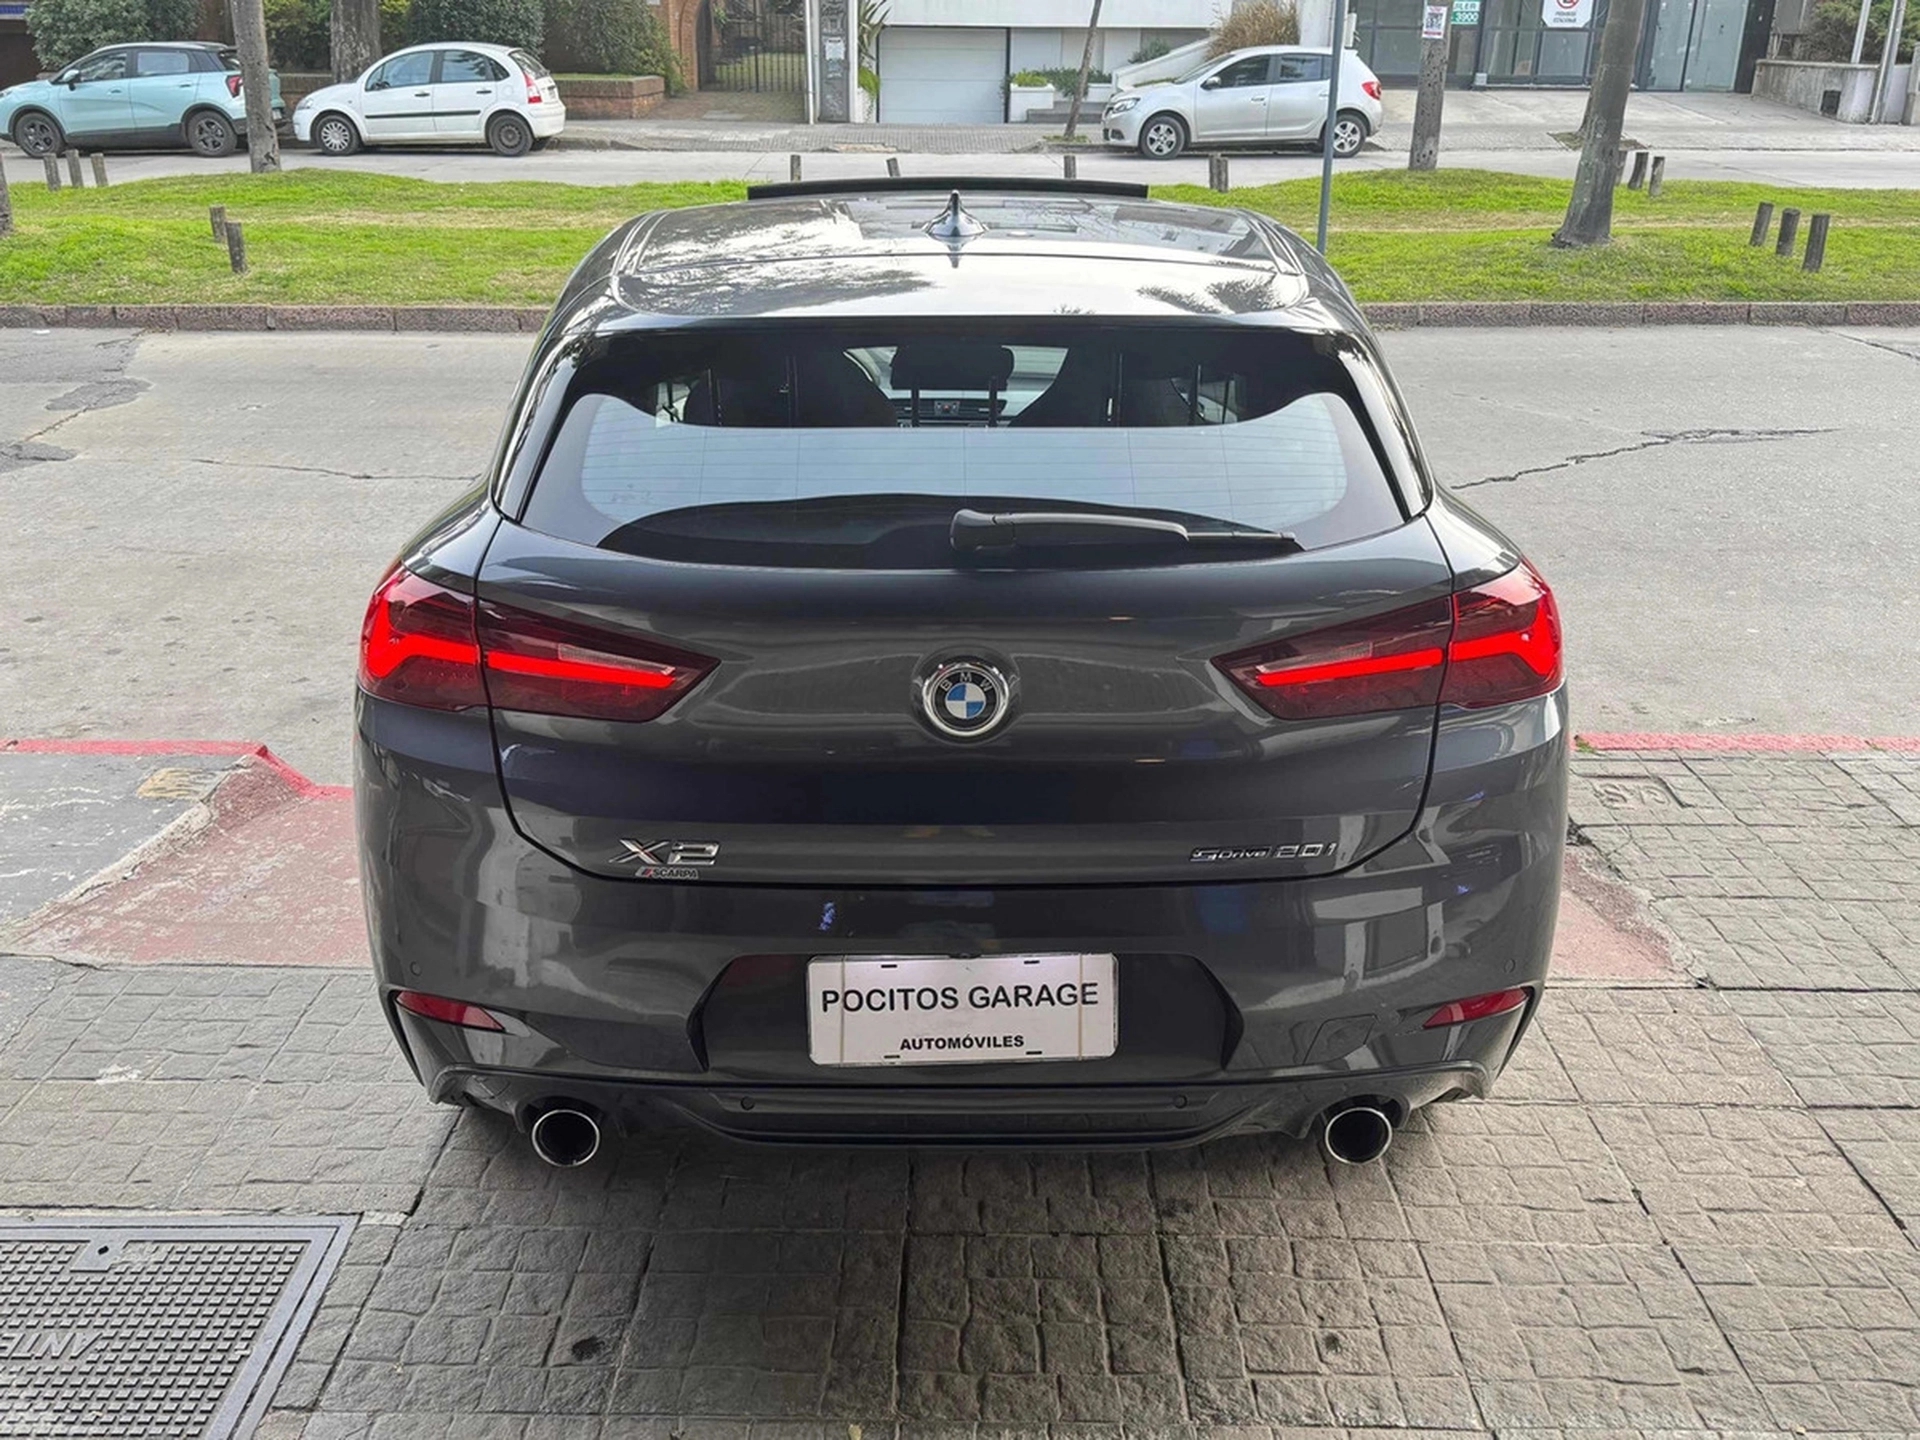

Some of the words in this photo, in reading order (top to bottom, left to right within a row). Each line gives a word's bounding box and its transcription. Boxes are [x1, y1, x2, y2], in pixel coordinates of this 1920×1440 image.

[940, 672, 993, 692] BMW
[608, 839, 719, 866] X2
[652, 867, 699, 879] SCARPA
[822, 986, 959, 1013] POCITOS
[968, 982, 1099, 1009] GARAGE
[900, 1033, 1025, 1051] AUTOMÓVILES
